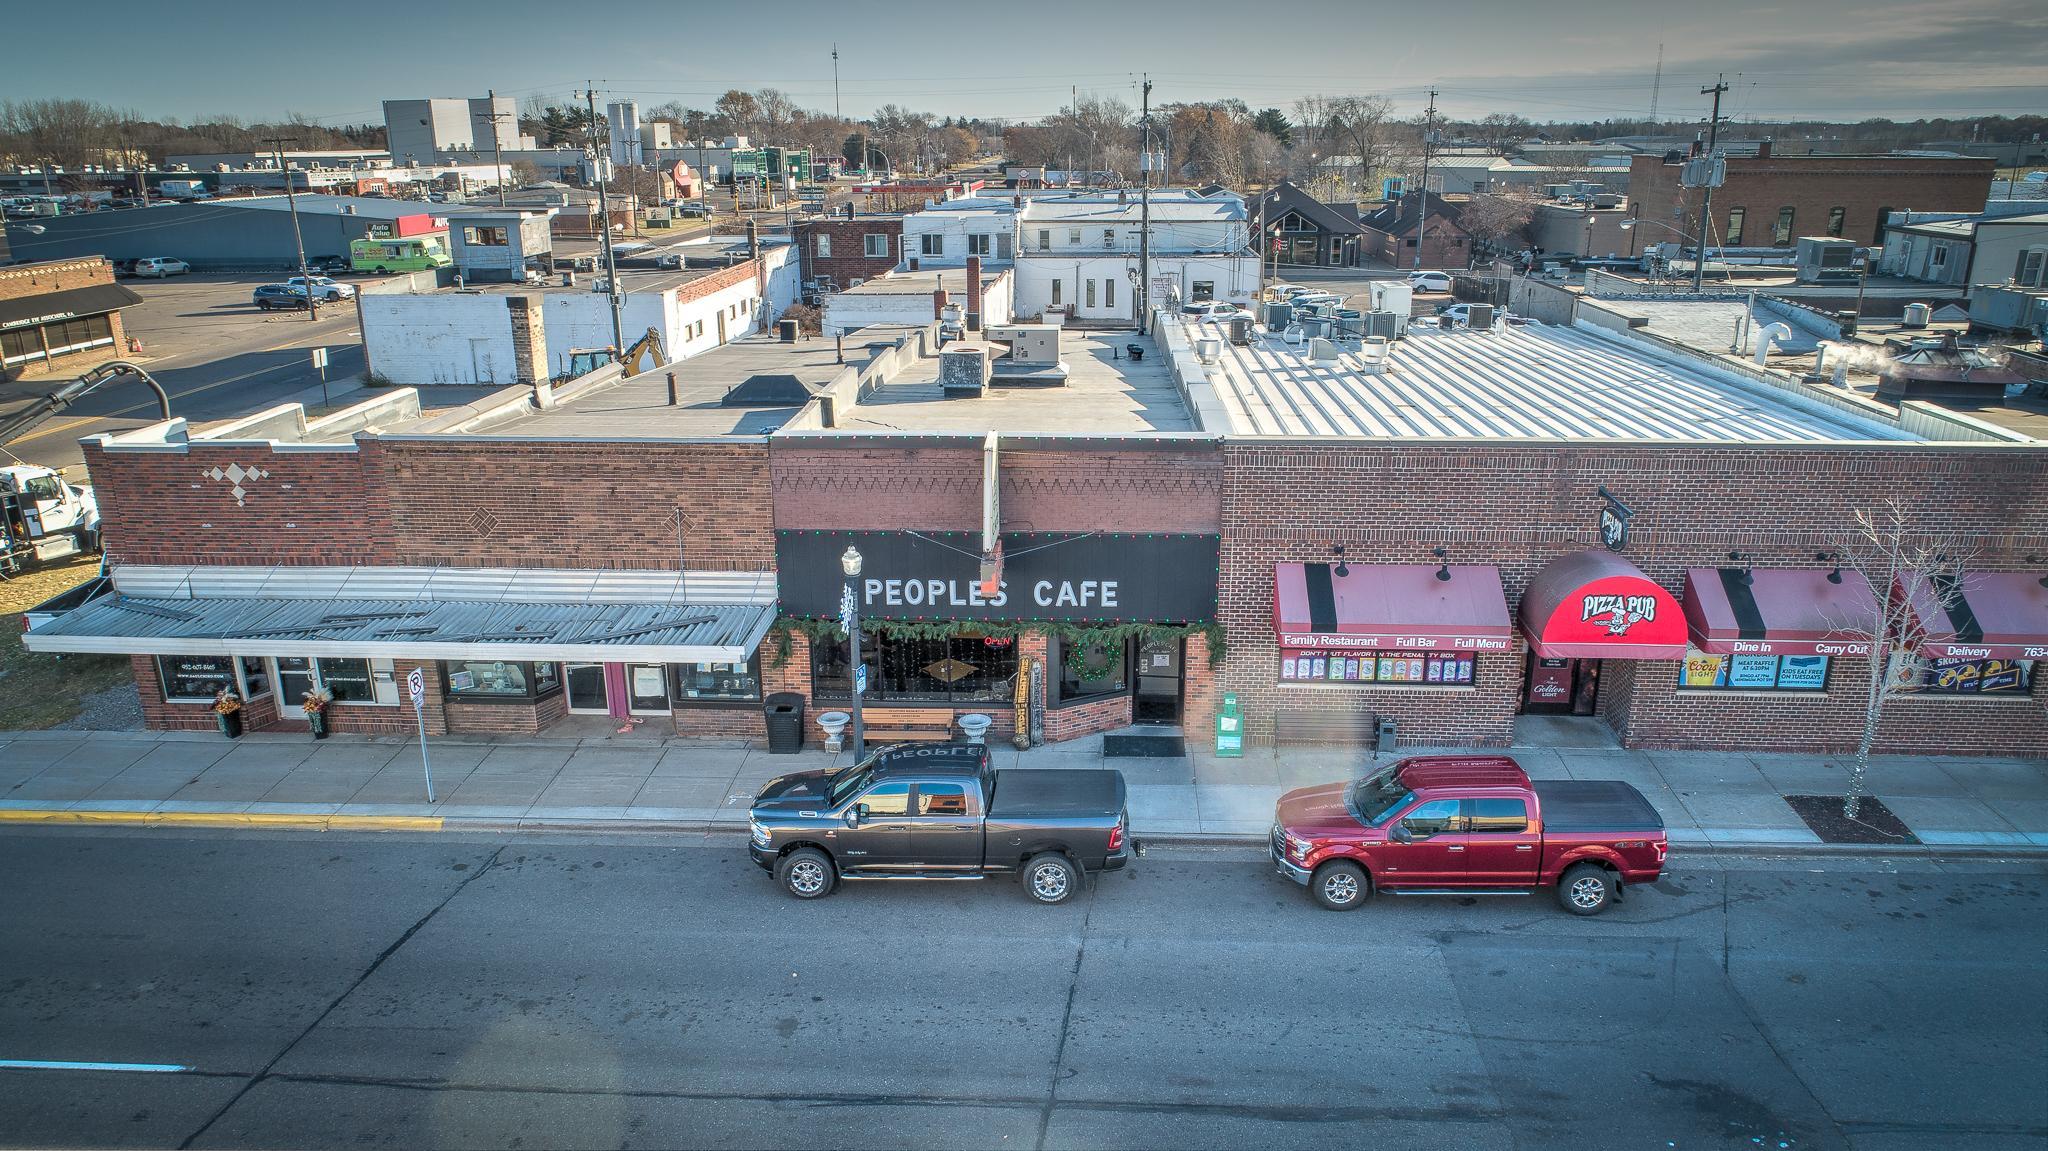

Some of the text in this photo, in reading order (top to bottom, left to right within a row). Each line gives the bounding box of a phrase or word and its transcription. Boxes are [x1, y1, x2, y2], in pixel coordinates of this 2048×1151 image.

[864, 578, 1118, 608] PEOPLES CAFE
[1582, 596, 1656, 622] PIZZA PUB
[984, 636, 1011, 645] OPEN
[1284, 636, 1378, 647] Family Restaurant
[1396, 637, 1437, 647] Full Bar
[1454, 638, 1506, 648] Full Menu
[1734, 642, 1772, 652] Dine In
[1816, 644, 1868, 656] Carry Out
[1948, 646, 1991, 658] Delivery
[2024, 648, 2048, 656] 763-
[1688, 660, 1717, 671] Coors
[1937, 658, 1960, 666] SKOL
